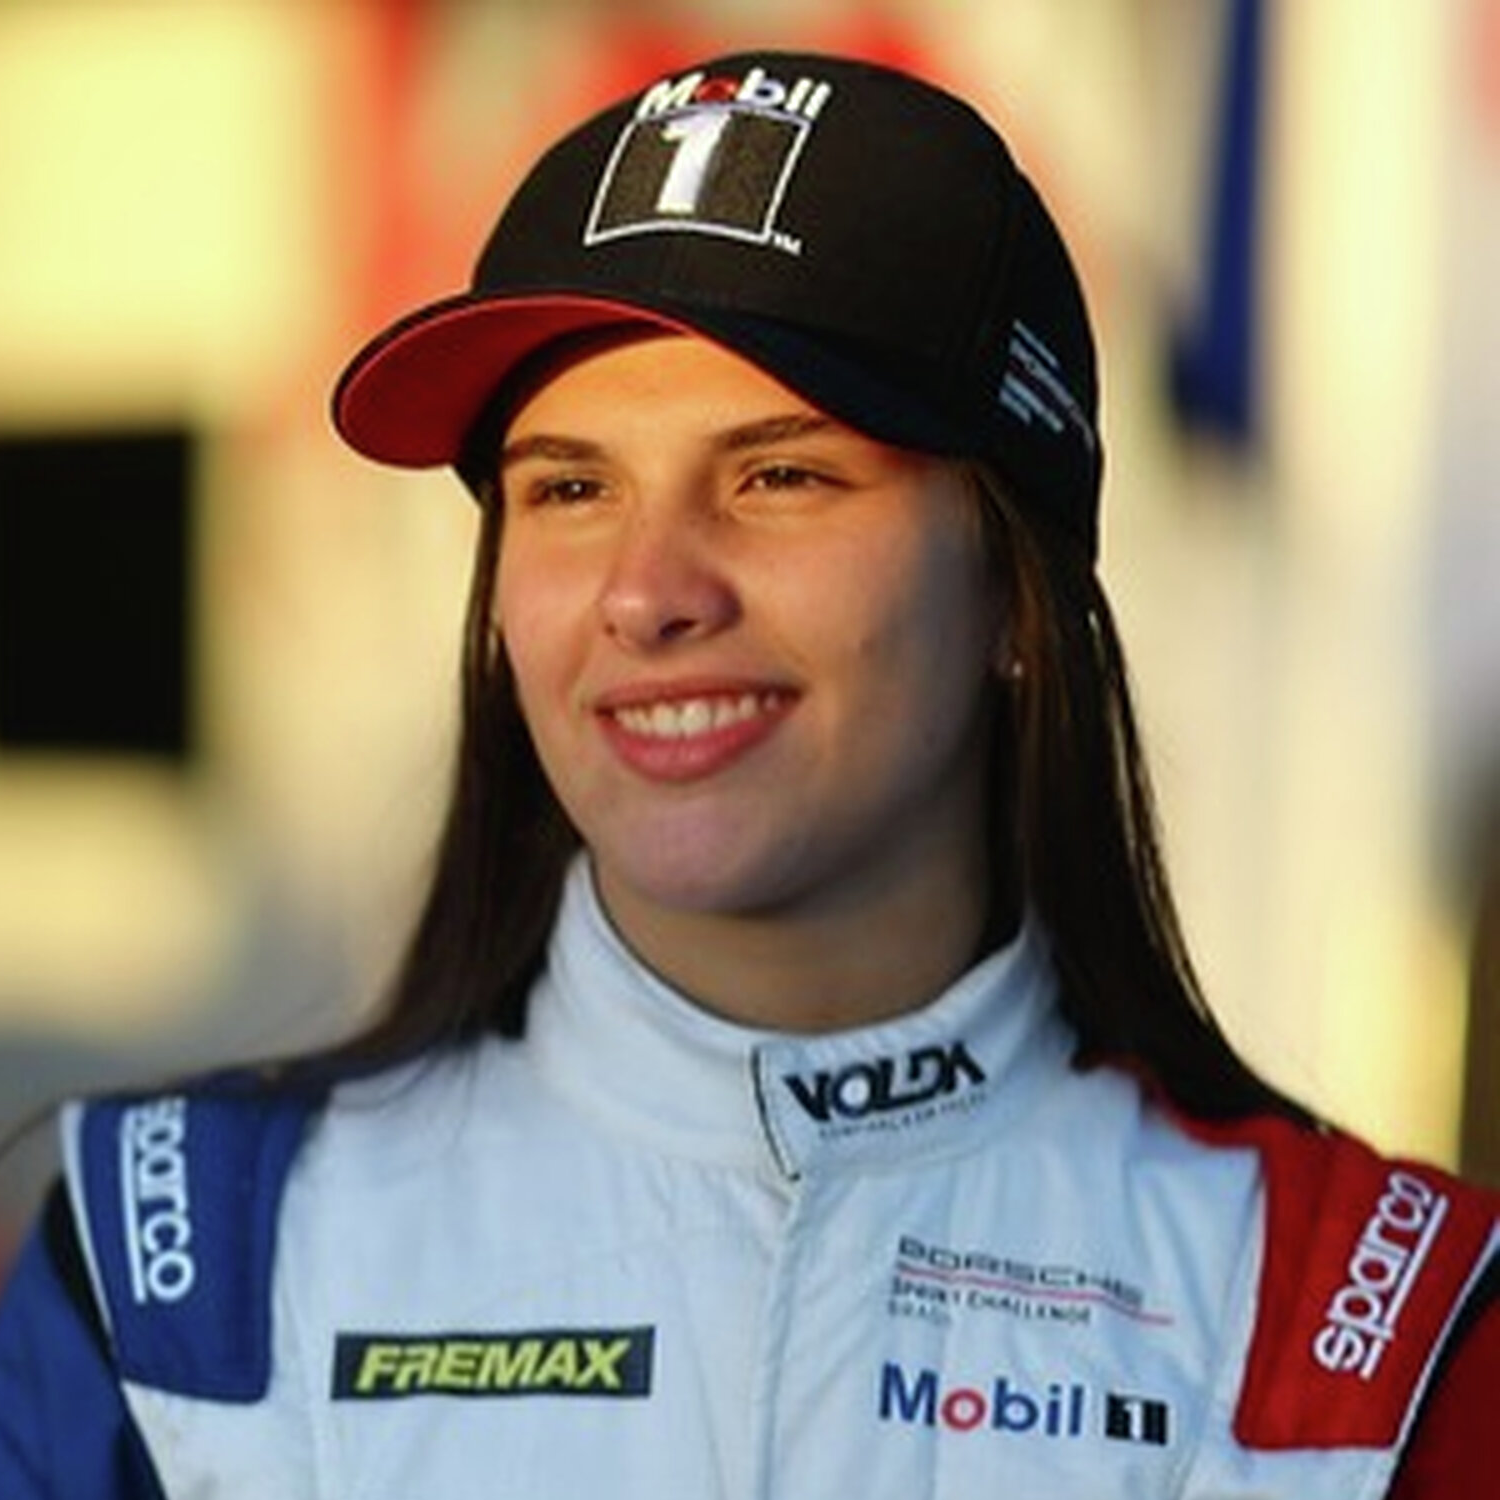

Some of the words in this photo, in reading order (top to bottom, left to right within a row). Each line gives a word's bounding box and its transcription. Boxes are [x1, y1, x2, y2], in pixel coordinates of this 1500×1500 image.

[635, 67, 832, 120] Mobil
[656, 109, 732, 214] 1
[898, 1234, 1145, 1312] PORSCHE
[1313, 1172, 1435, 1372] sparco
[355, 1338, 631, 1392] FREMAX
[879, 1362, 1084, 1437] Mobil
